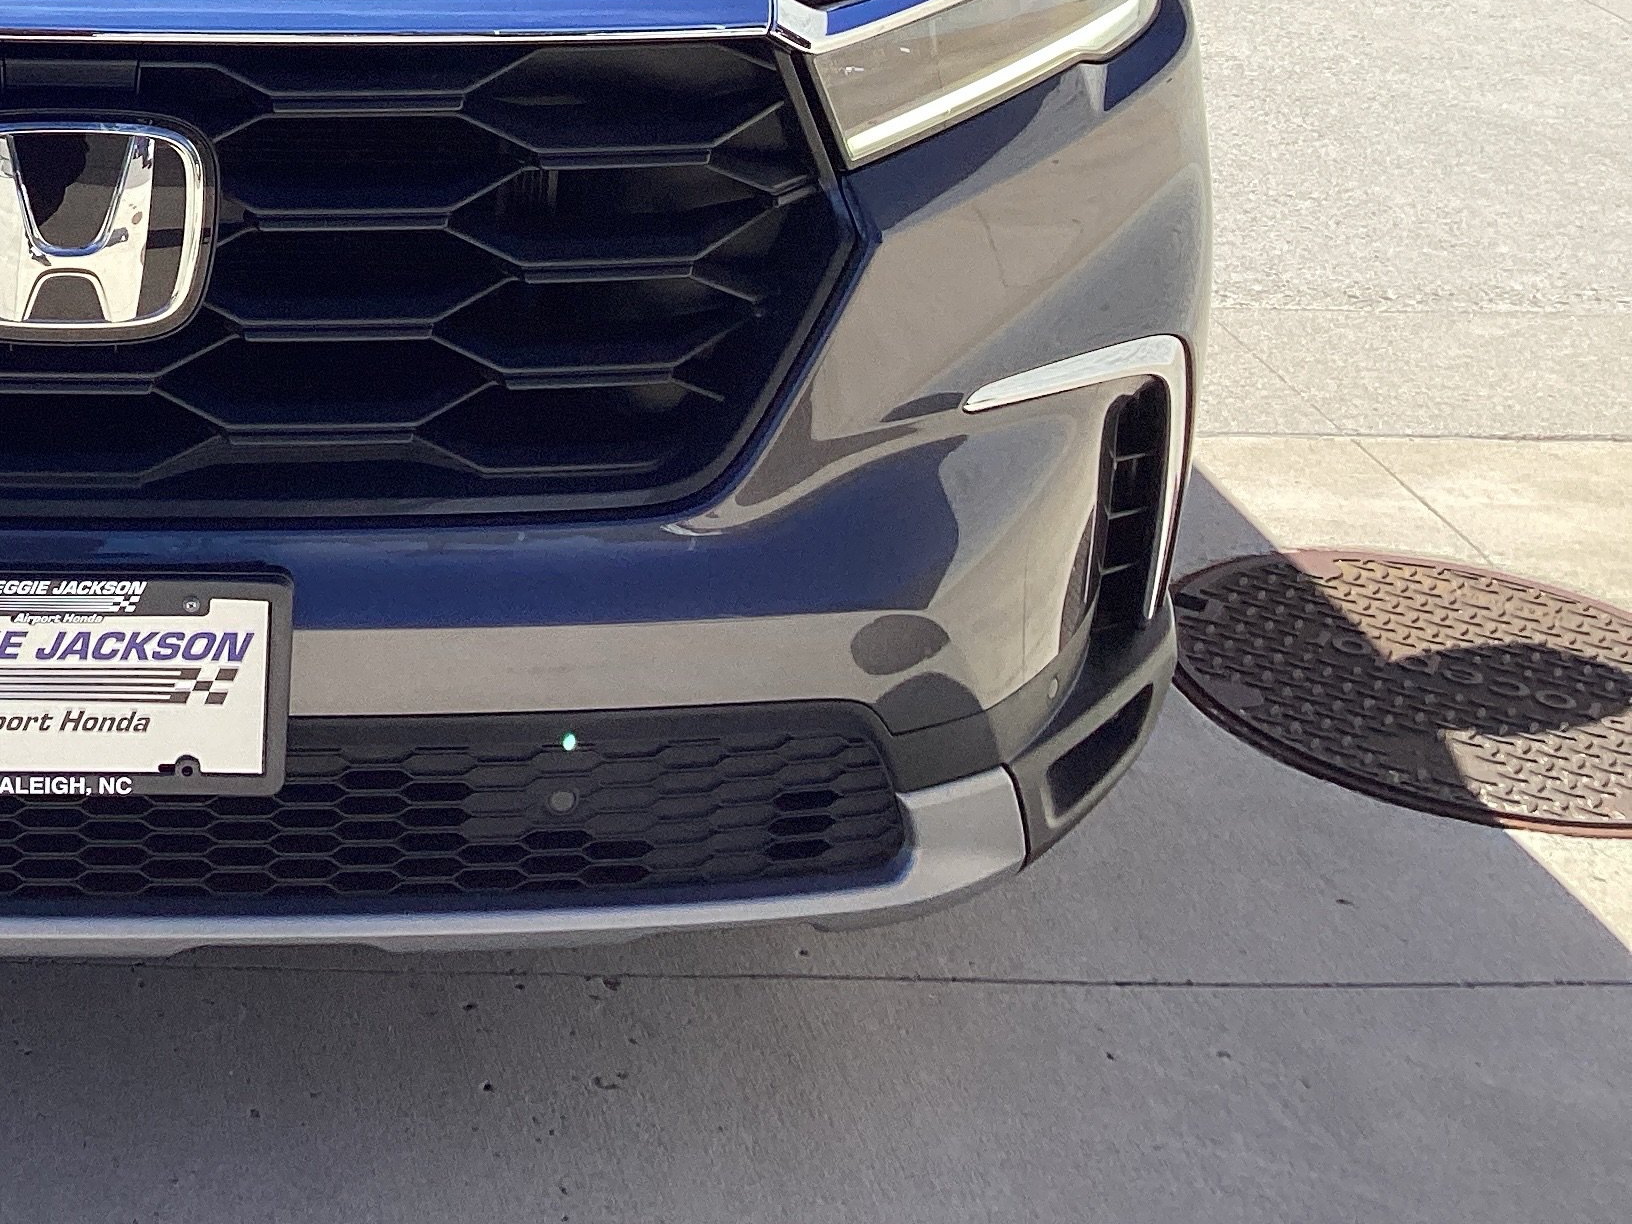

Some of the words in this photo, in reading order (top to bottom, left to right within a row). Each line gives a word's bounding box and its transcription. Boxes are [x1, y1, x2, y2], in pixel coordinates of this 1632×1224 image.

[52, 580, 147, 596] JACKSON
[14, 613, 61, 625] Airport
[62, 613, 104, 624] Honda
[34, 630, 255, 662] JACKSON
[58, 708, 152, 733] Honda
[98, 776, 133, 795] NC
